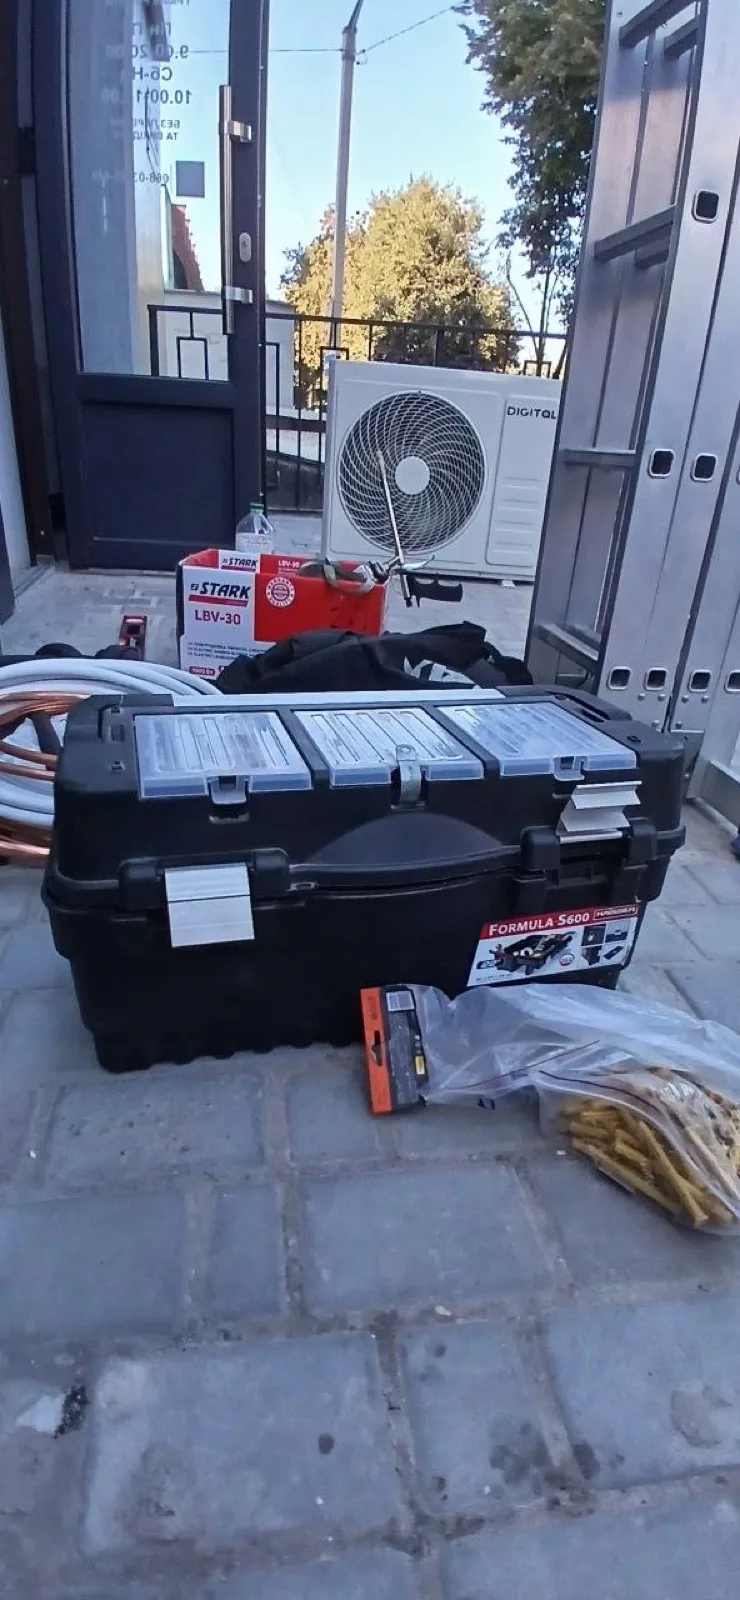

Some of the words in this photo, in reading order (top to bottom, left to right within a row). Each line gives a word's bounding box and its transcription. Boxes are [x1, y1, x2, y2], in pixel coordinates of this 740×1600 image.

[229, 557, 258, 567] STARK
[200, 582, 252, 600] STARK
[194, 609, 242, 625] LBV-30
[488, 918, 555, 936] FORMULA
[557, 912, 590, 927] S600
